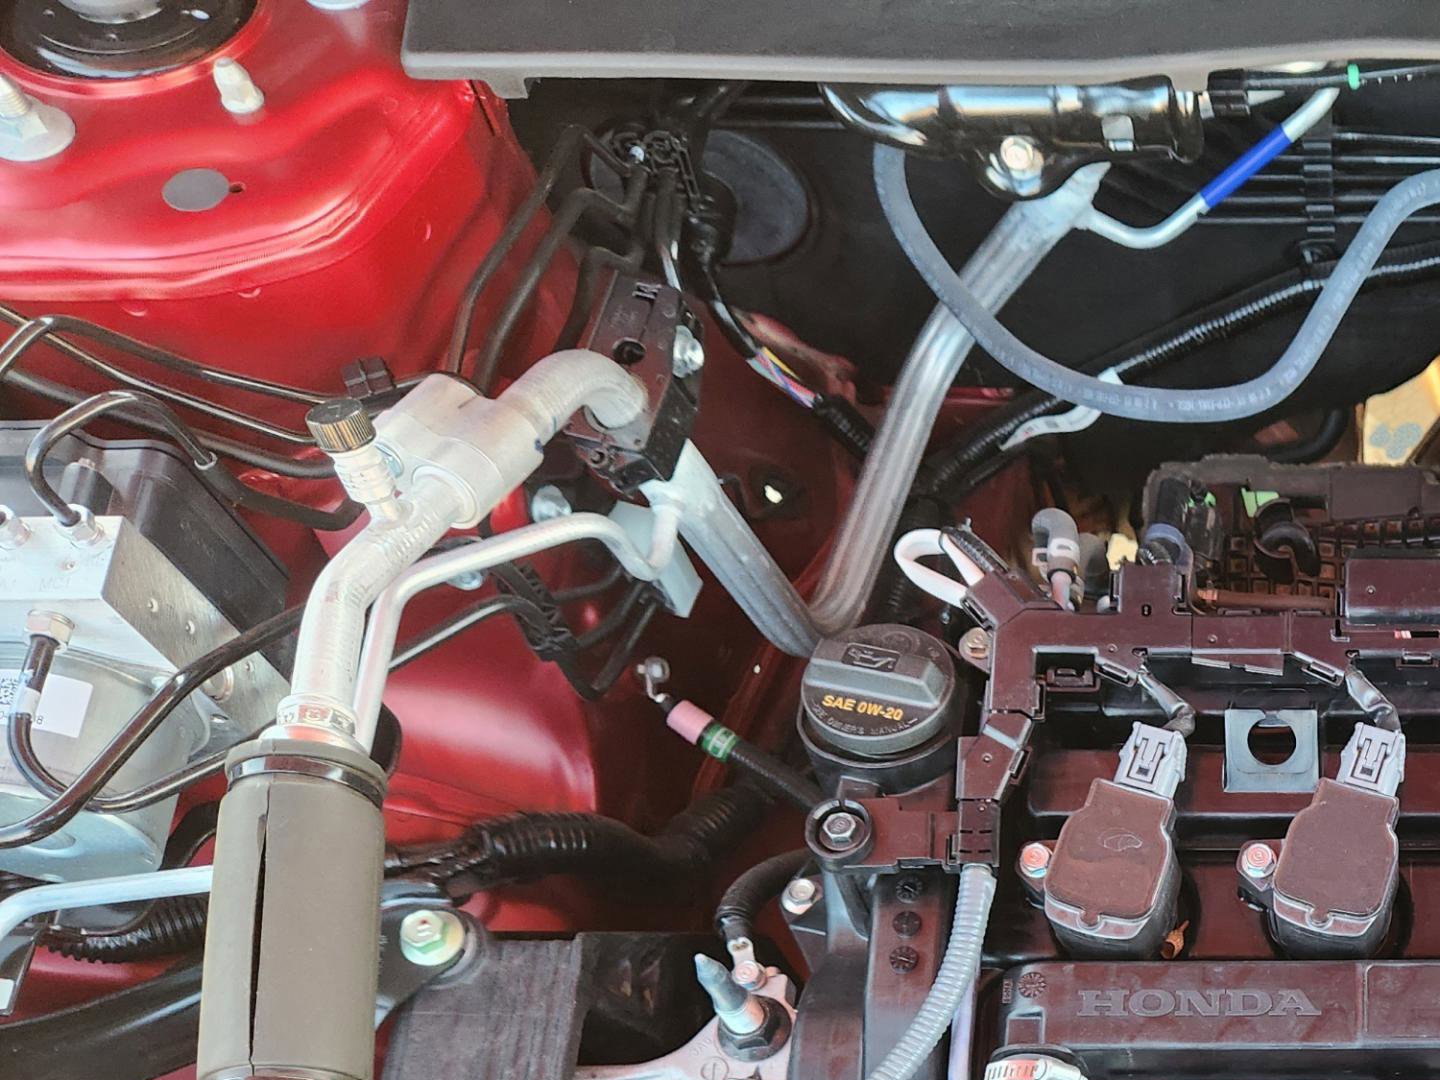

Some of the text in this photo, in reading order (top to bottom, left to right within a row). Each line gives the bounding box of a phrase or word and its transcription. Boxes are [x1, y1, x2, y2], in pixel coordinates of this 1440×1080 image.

[822, 694, 904, 720] SAE 0W-20
[1077, 988, 1322, 1017] HONDA
